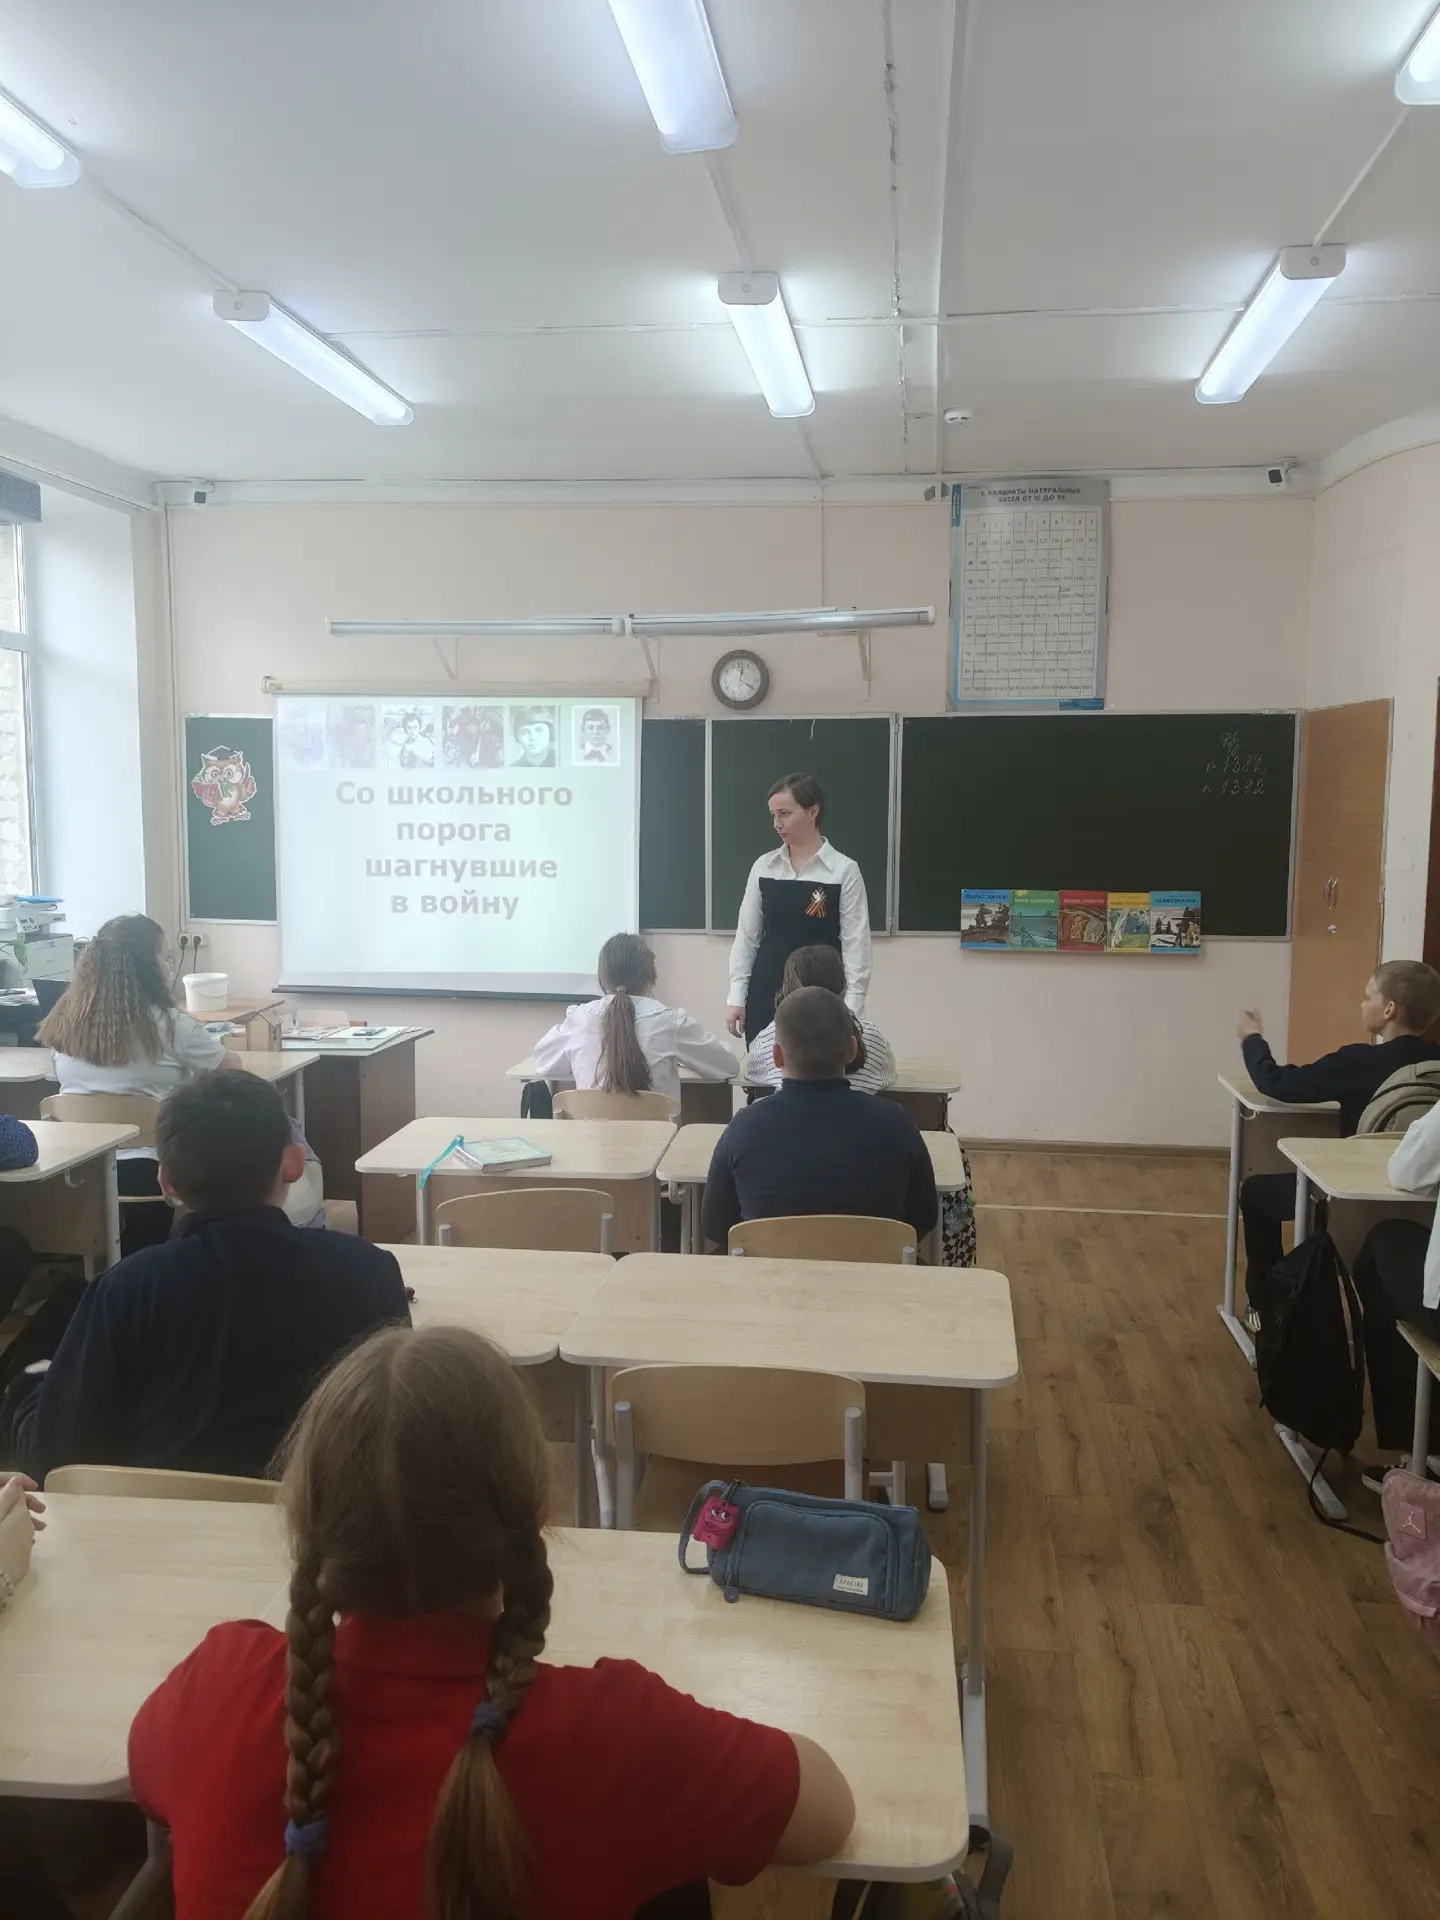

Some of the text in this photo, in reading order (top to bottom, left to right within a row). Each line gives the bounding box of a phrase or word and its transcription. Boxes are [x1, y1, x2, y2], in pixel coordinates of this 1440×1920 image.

[336, 781, 573, 806] Со школьного
[396, 821, 512, 846] порога
[365, 857, 558, 883] шагнувшие
[391, 889, 520, 920] в войну
